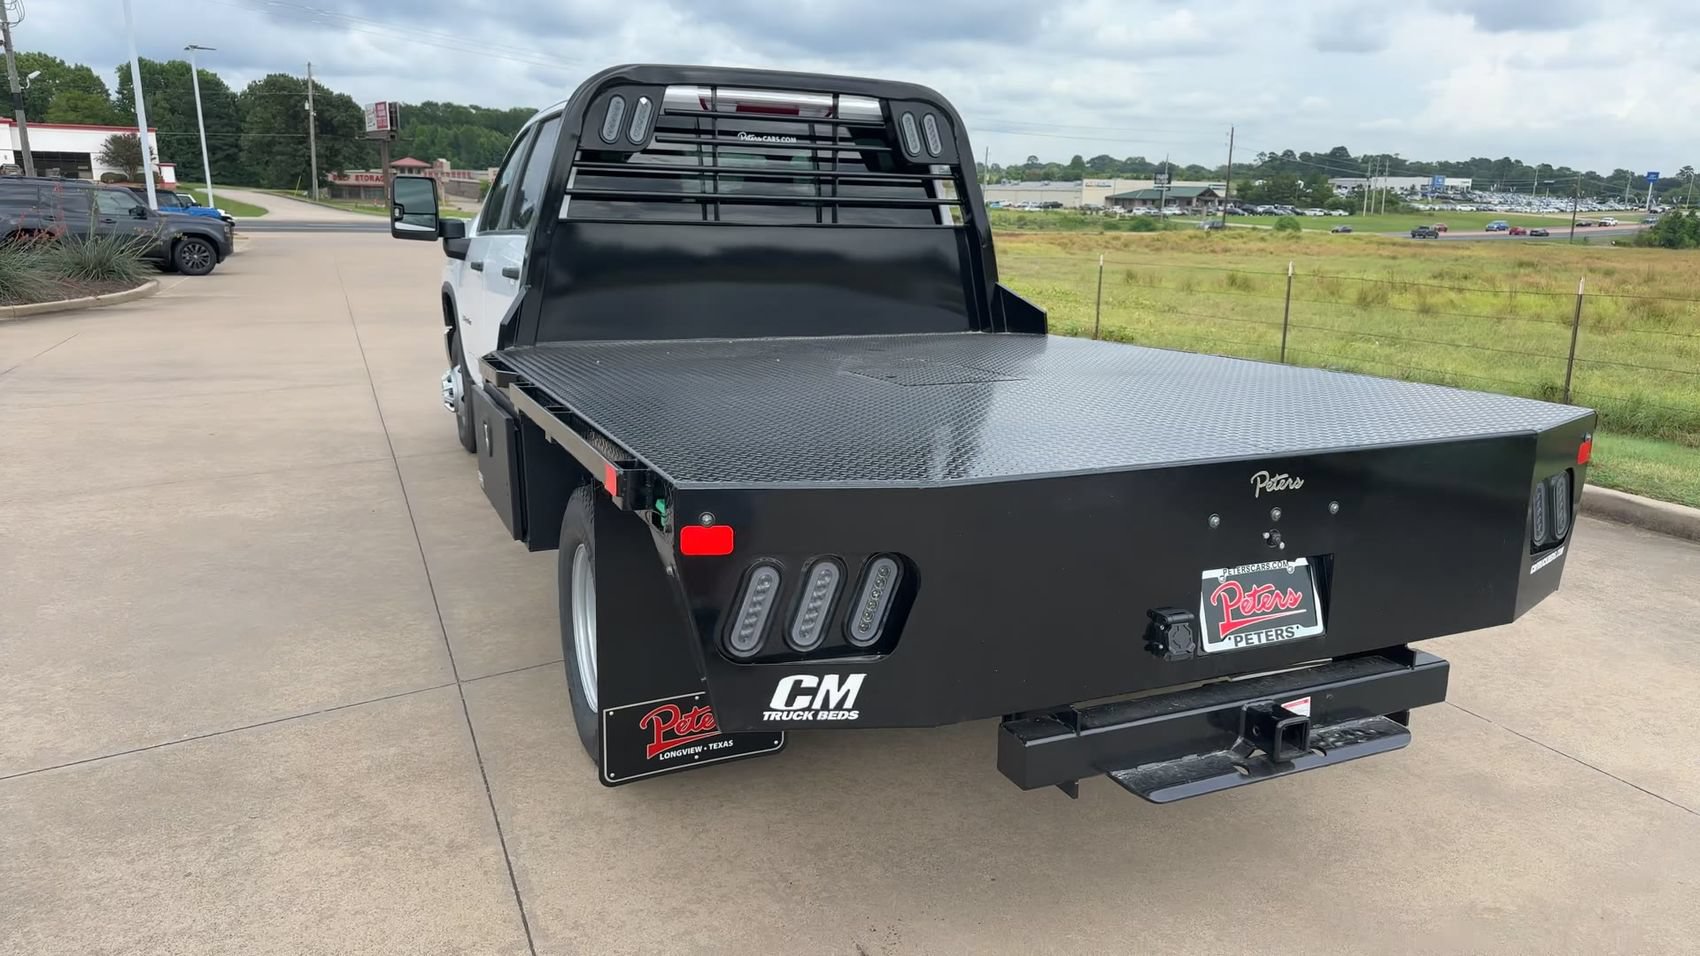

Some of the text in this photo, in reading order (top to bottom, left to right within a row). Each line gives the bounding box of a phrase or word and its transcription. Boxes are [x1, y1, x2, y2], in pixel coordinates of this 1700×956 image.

[1250, 470, 1305, 498] Peters
[1222, 560, 1290, 575] PETERSCARS.COM
[1210, 580, 1304, 637] Peters
[1233, 626, 1295, 647] PETERS
[769, 673, 868, 710] CM
[762, 710, 860, 721] TRUCK BEDS
[639, 703, 717, 758] Pete
[659, 739, 734, 761] LONGVIEW TEXAS
